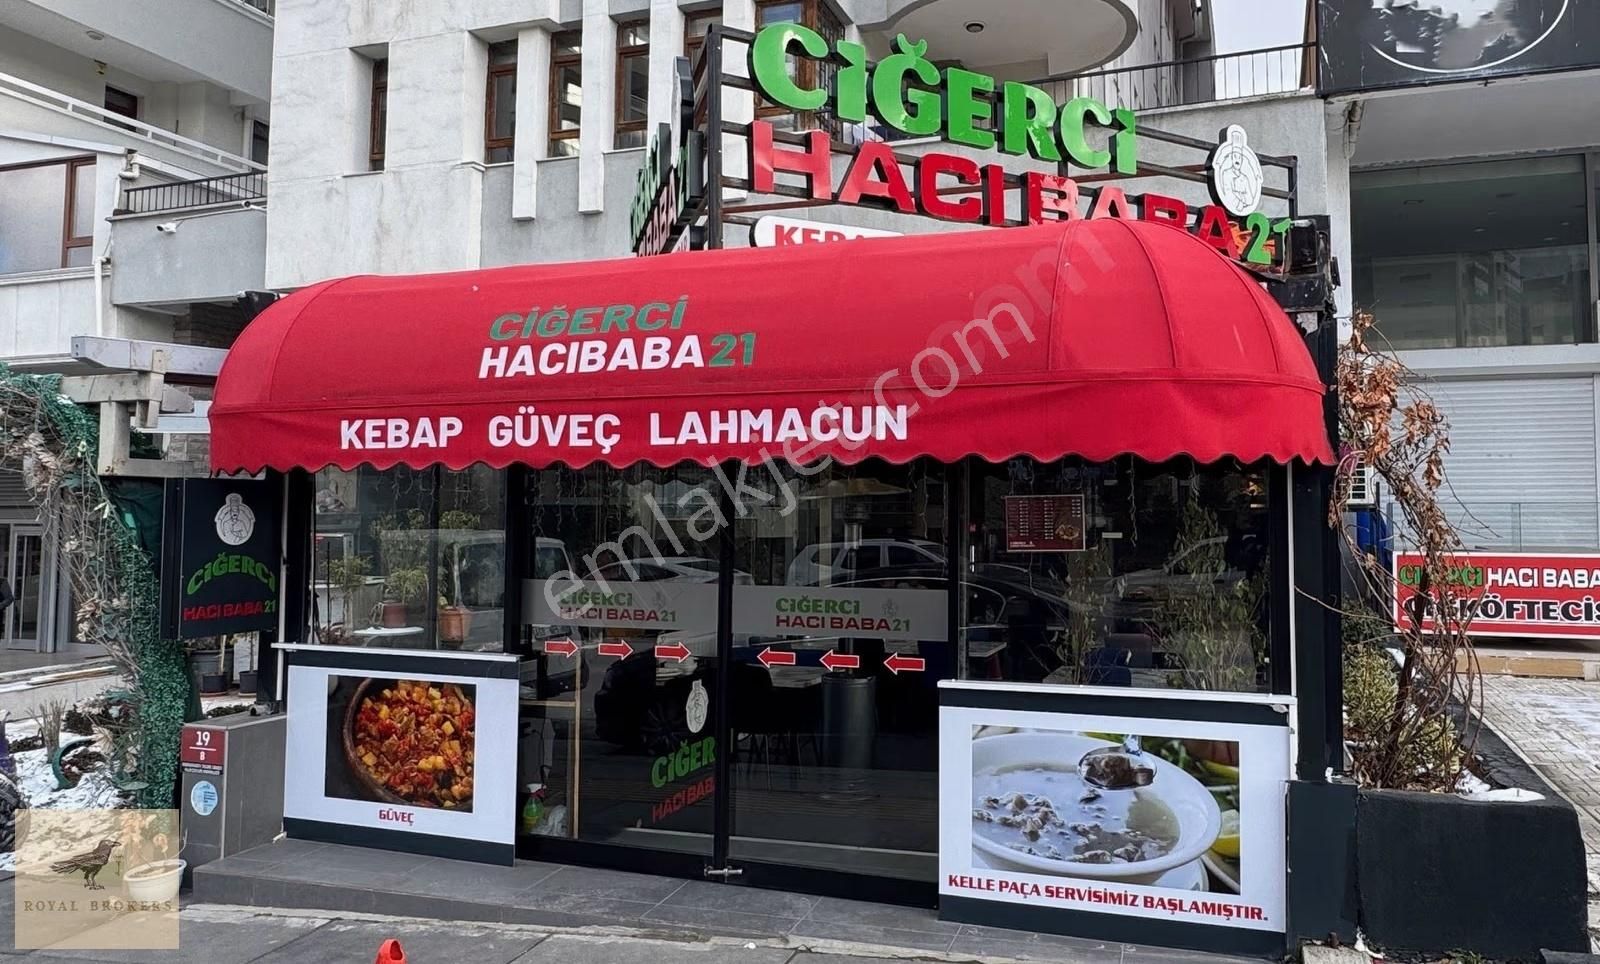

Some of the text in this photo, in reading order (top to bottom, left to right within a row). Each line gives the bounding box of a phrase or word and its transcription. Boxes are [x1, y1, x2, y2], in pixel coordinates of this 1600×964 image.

[752, 120, 1004, 226] HACI
[489, 294, 690, 342] CİĞERCİ
[340, 404, 909, 455] KEBAP GÜVEÇ LAHMACUN
[1487, 567, 1539, 588] HACI
[1542, 568, 1600, 589] BABA
[184, 603, 221, 621] HACI
[776, 615, 825, 629] HACI
[195, 731, 211, 746] 19
[199, 750, 206, 761] 8
[651, 736, 717, 788] CİĞER
[687, 775, 715, 807] BAB
[378, 807, 414, 827] GÜVEÇ
[948, 874, 1269, 922] KELLE PAÇA SERVİSİMİZ BAŞLAMIŞTIR.
